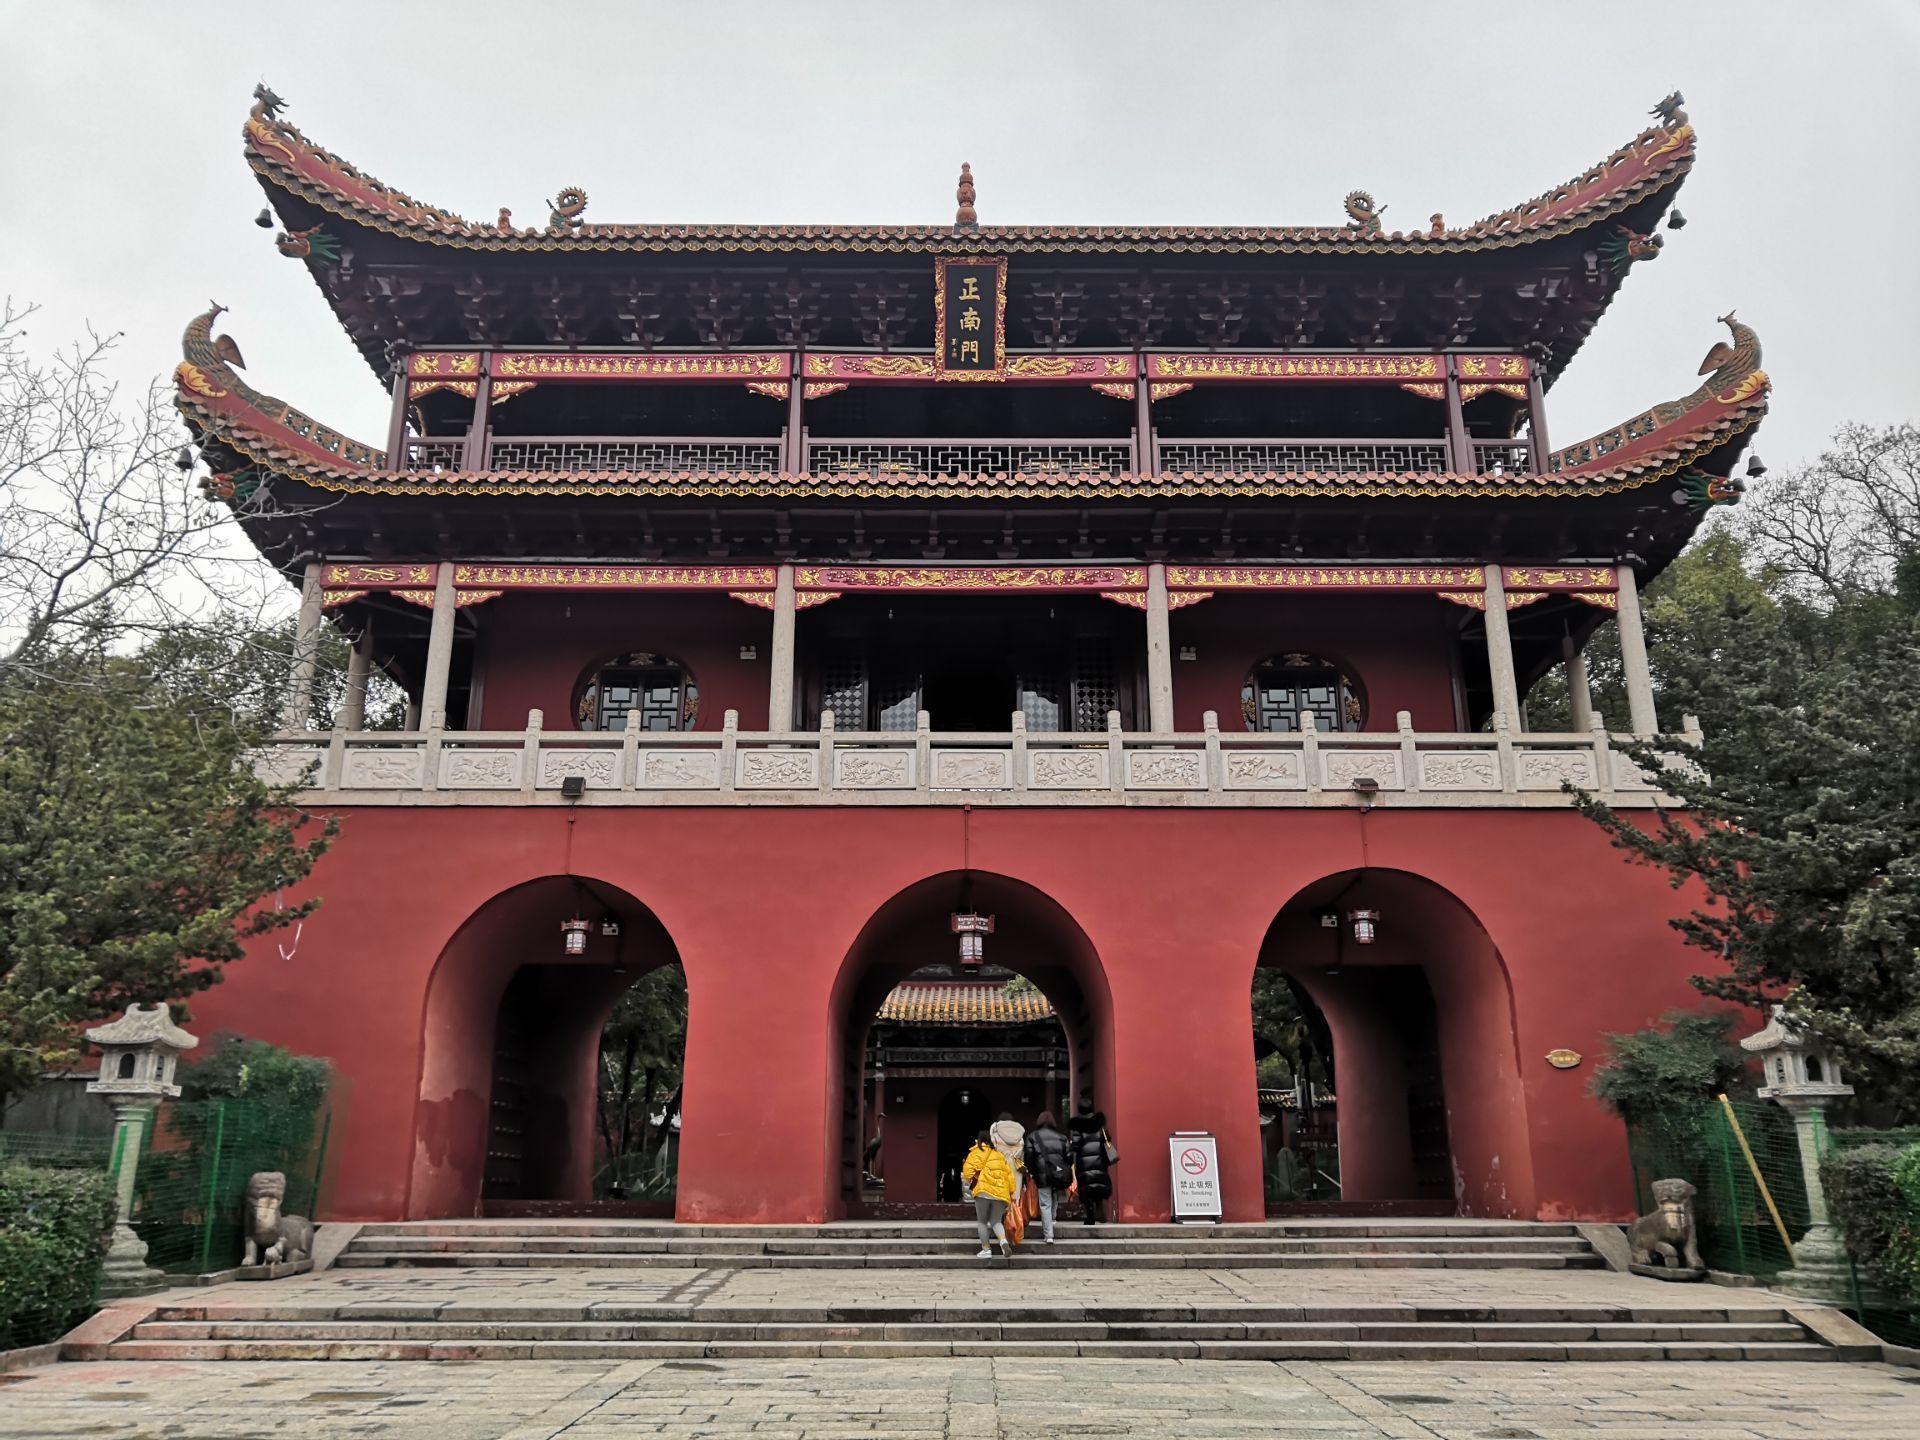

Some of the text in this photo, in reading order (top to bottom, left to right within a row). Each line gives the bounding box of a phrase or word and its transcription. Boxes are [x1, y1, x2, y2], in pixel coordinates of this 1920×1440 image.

[958, 277, 981, 363] 正南門
[1180, 1181, 1213, 1189] 禁止吸烟
